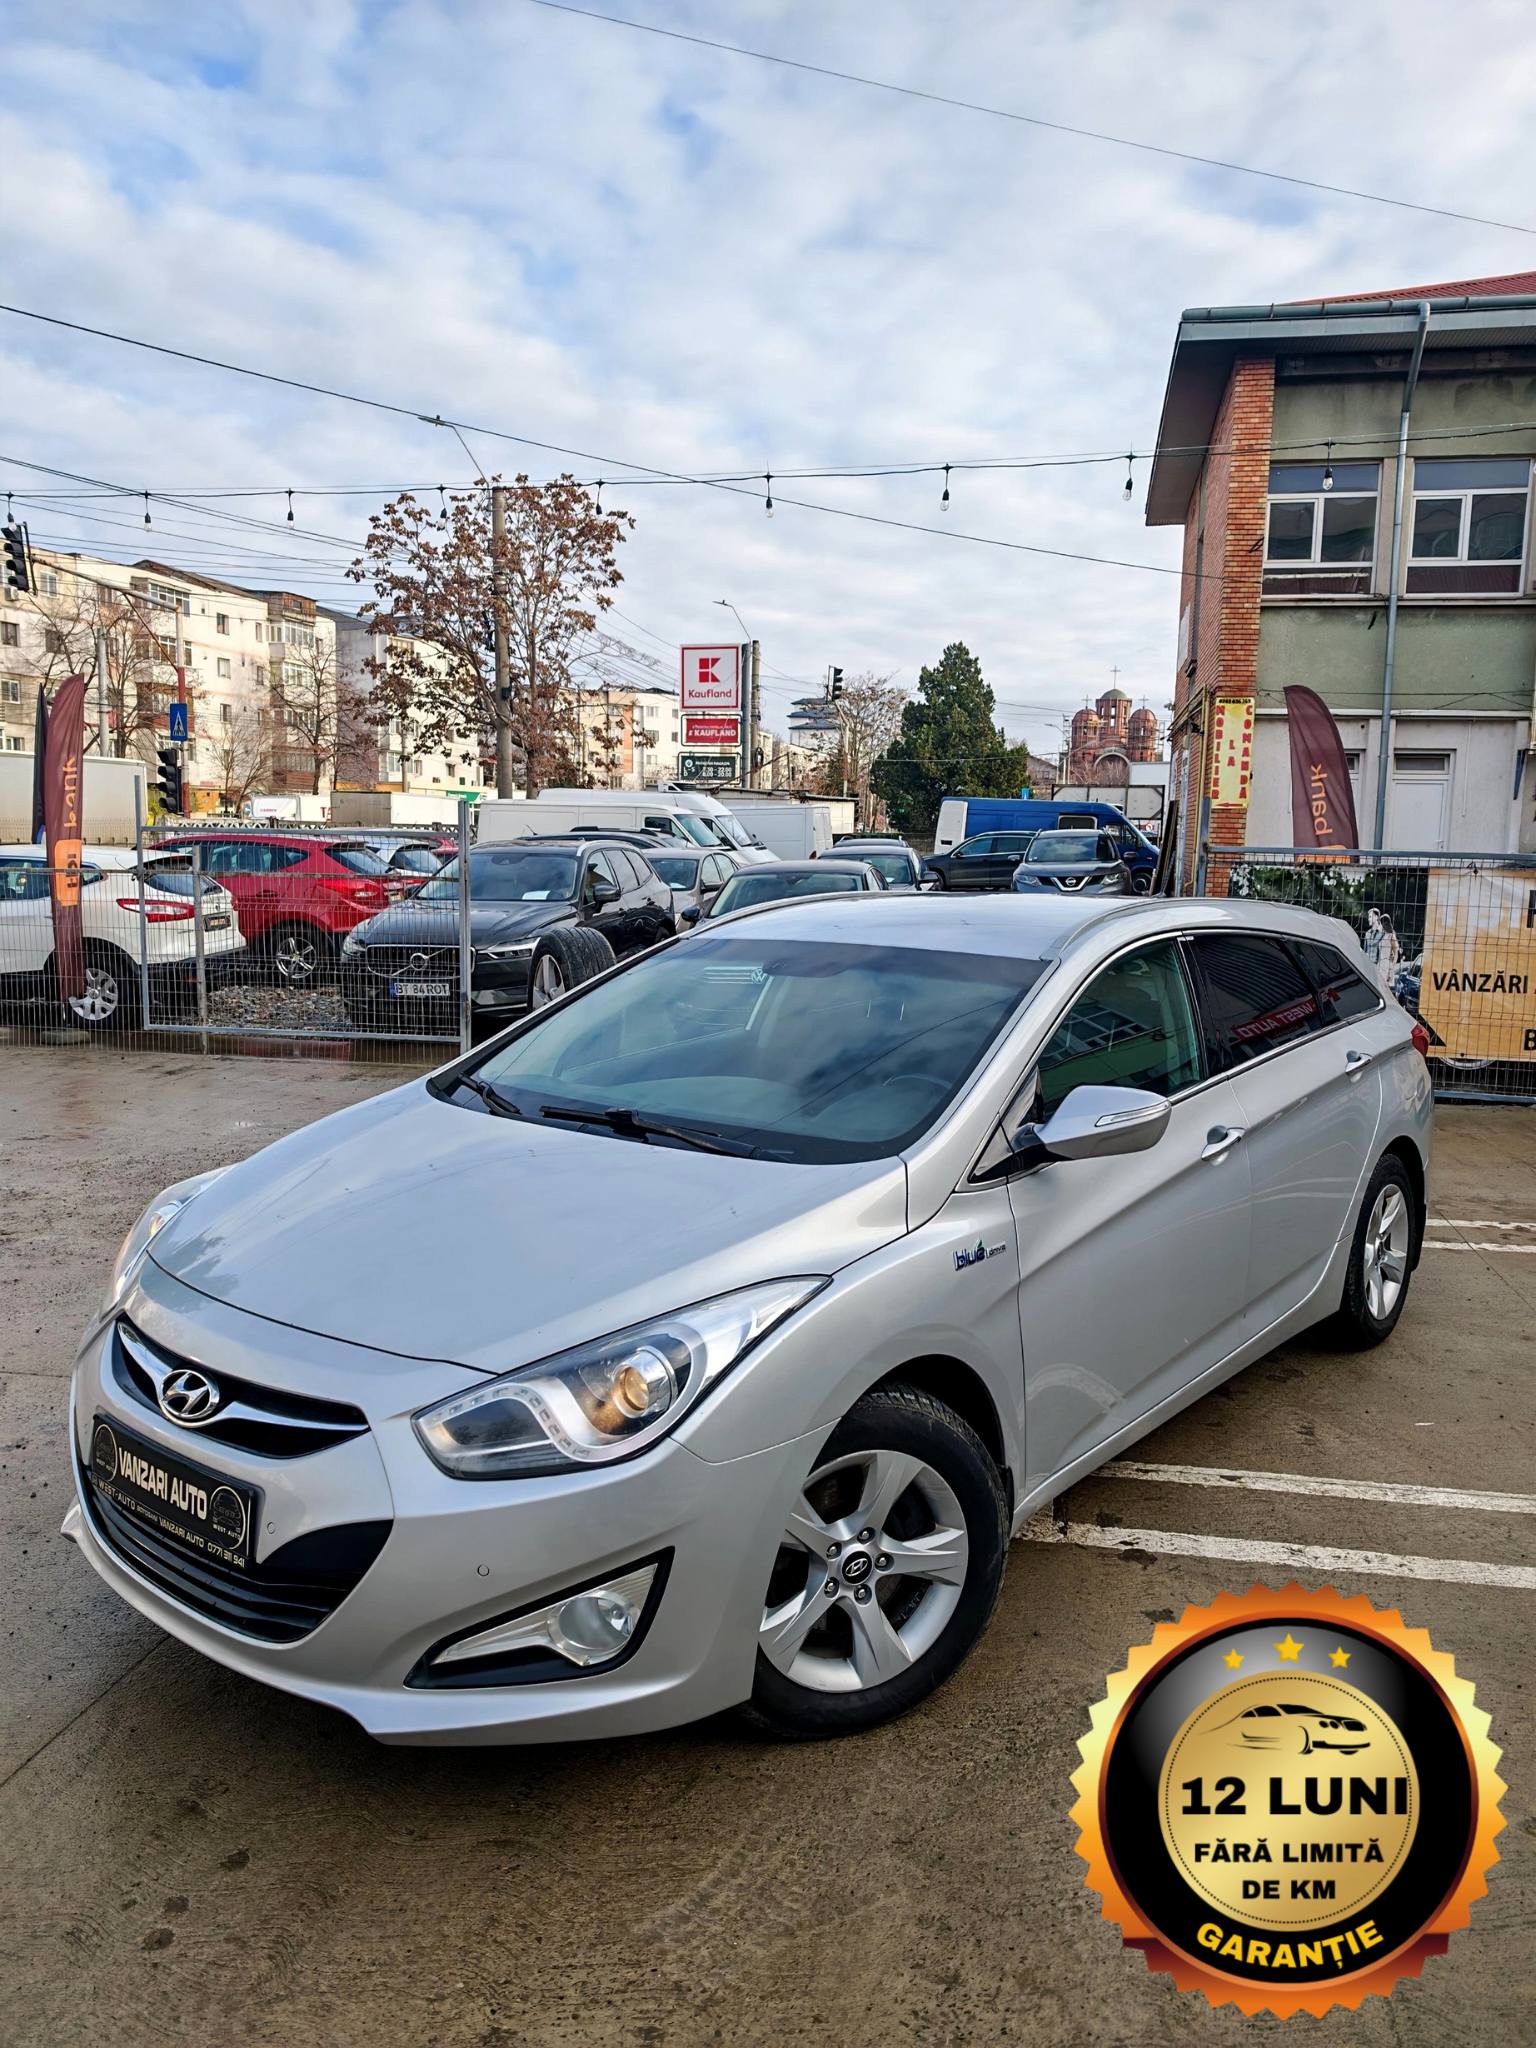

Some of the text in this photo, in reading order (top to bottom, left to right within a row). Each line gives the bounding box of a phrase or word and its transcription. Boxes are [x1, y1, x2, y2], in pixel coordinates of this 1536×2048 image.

[688, 689, 732, 698] Kaufland
[1227, 740, 1236, 766] LA
[1432, 968, 1528, 994] VÂNZĂRI
[118, 1447, 207, 1520] VANZARI AUTO
[186, 1532, 204, 1548] AUTO
